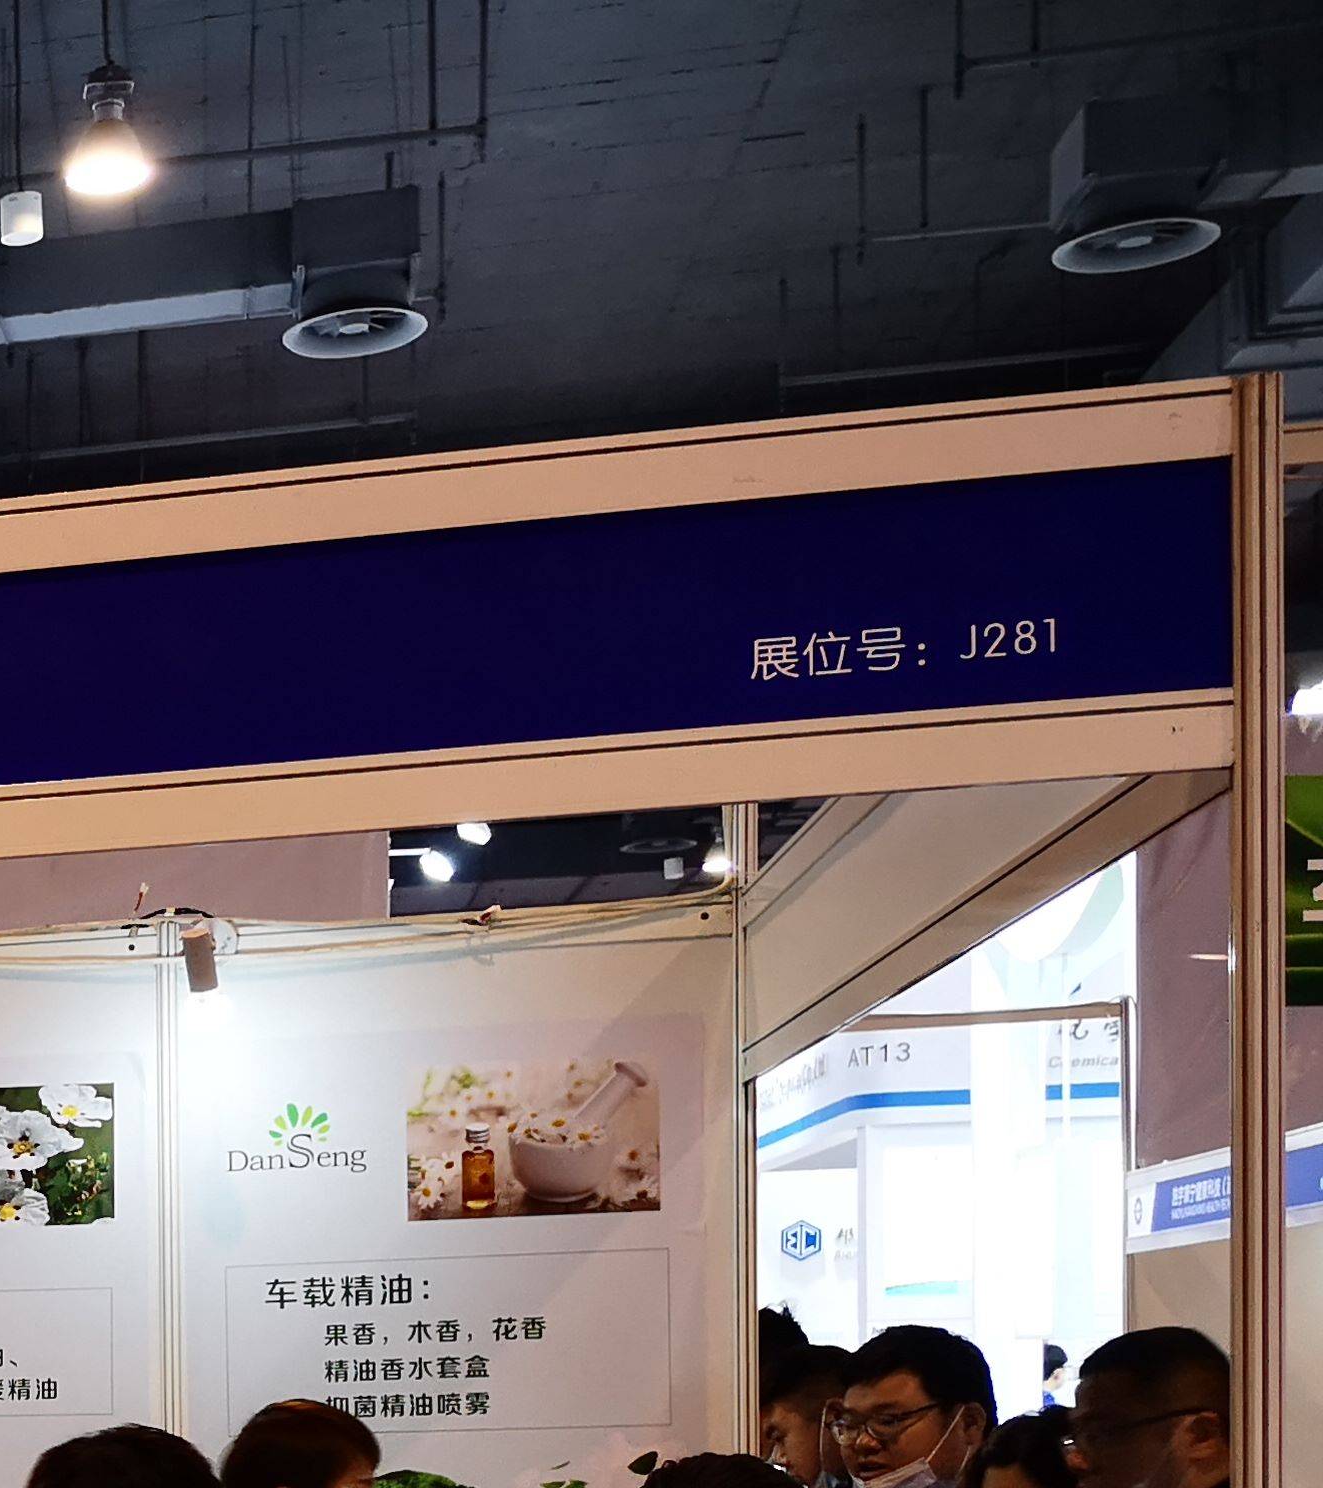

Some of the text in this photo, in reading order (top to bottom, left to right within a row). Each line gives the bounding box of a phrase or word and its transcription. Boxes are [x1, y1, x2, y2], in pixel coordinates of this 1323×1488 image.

[959, 617, 1058, 661] J281
[848, 1042, 912, 1068] AT13
[227, 1132, 368, 1174] DanSeng
[264, 1273, 431, 1309] 车载精油：
[323, 1354, 491, 1383] 精油香水套盒
